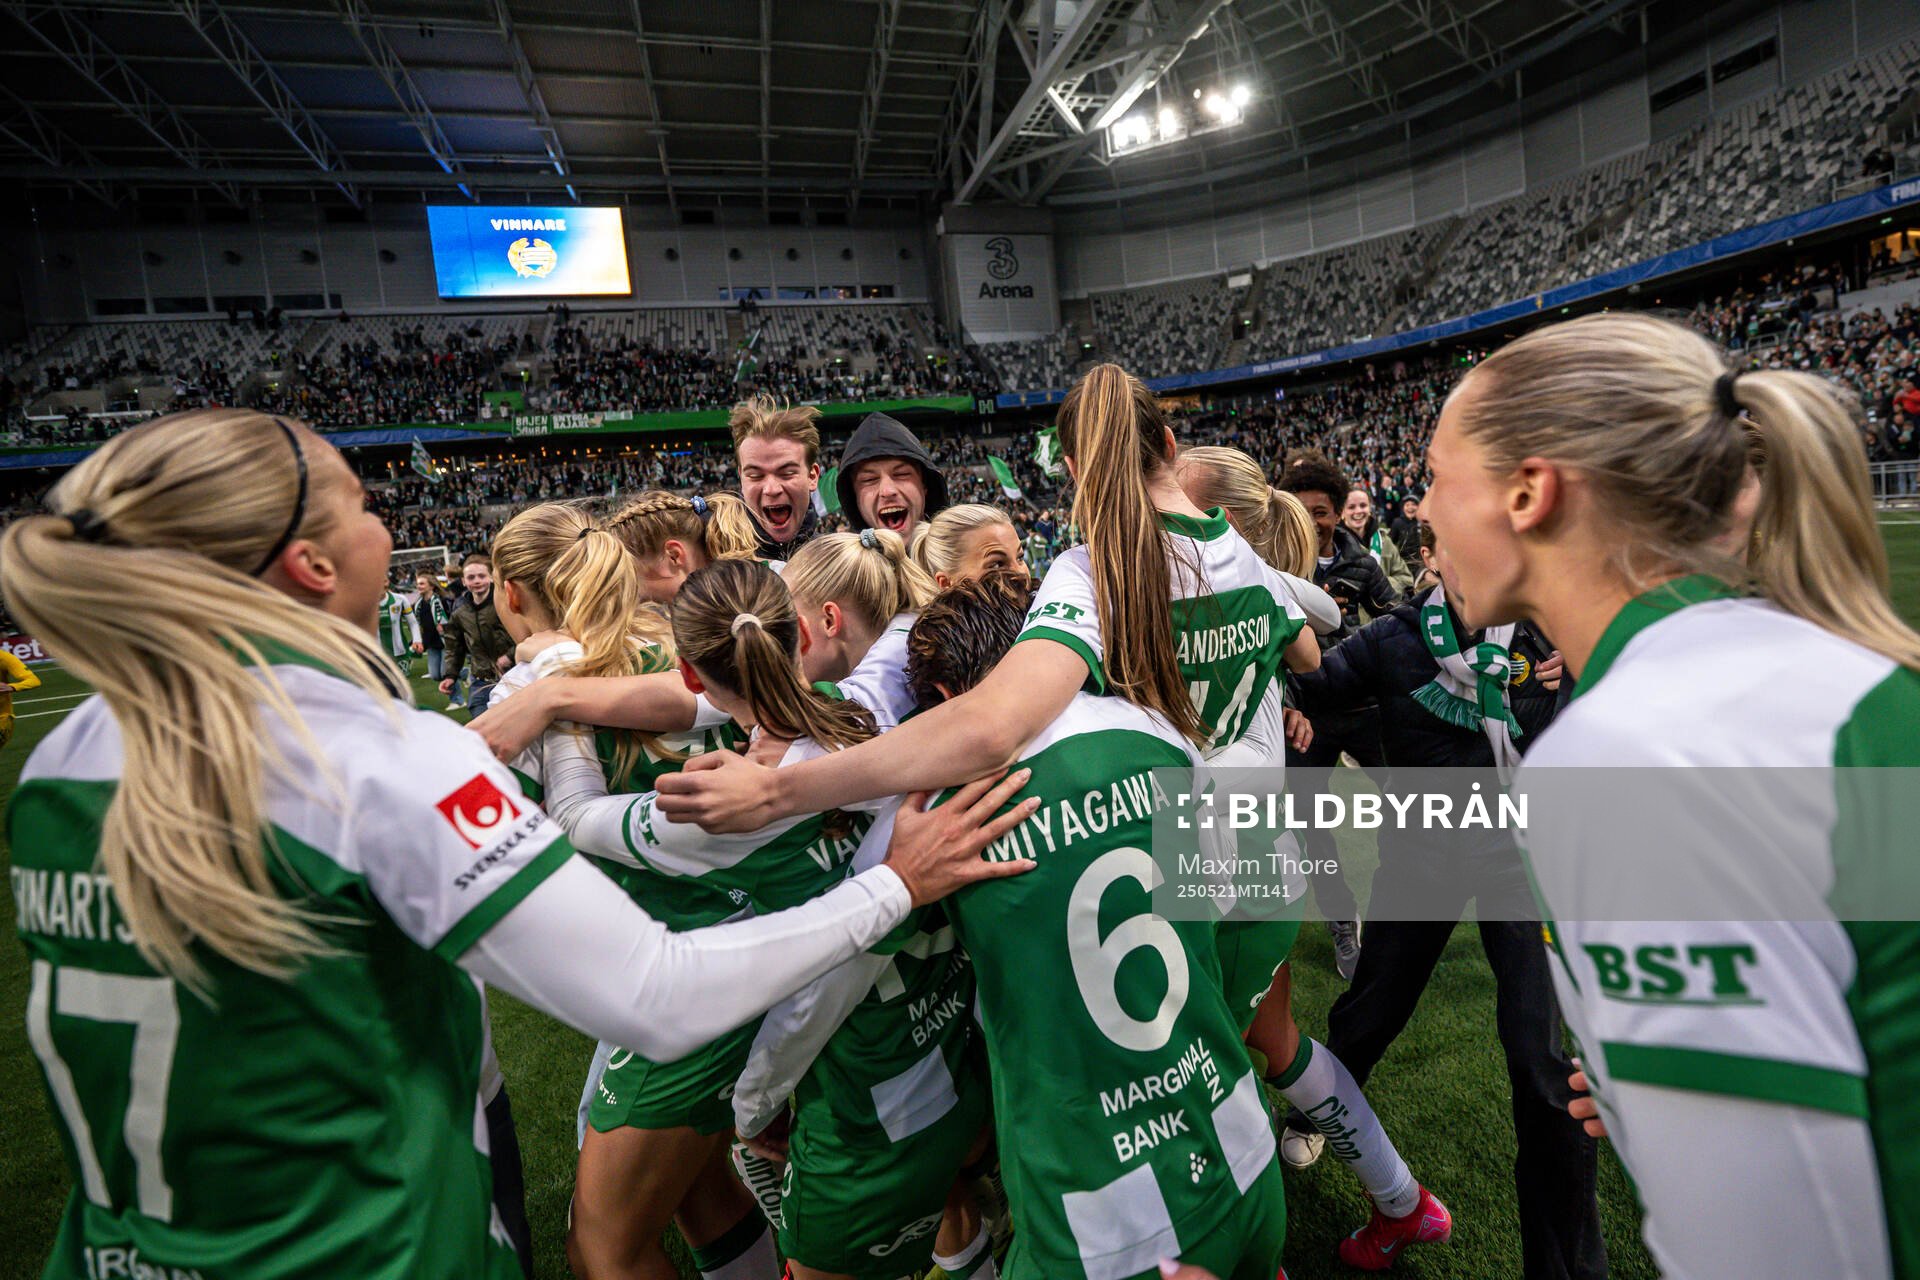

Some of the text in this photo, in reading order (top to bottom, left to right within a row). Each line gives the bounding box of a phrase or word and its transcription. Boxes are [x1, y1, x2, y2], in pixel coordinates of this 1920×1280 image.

[490, 219, 567, 231] VINNARE
[984, 237, 1019, 280] 3
[979, 282, 1034, 298] Arena
[1175, 614, 1270, 665] ANDERSSON
[983, 771, 1171, 864] MIYAGAWA
[454, 831, 527, 891] SVENSKA
[1067, 847, 1189, 1051] 6
[1580, 943, 1758, 995] BST
[911, 991, 966, 1048] BANK
[26, 960, 181, 1222] 17
[1112, 1109, 1190, 1163] BANK
[1304, 1095, 1362, 1160] Clinton
